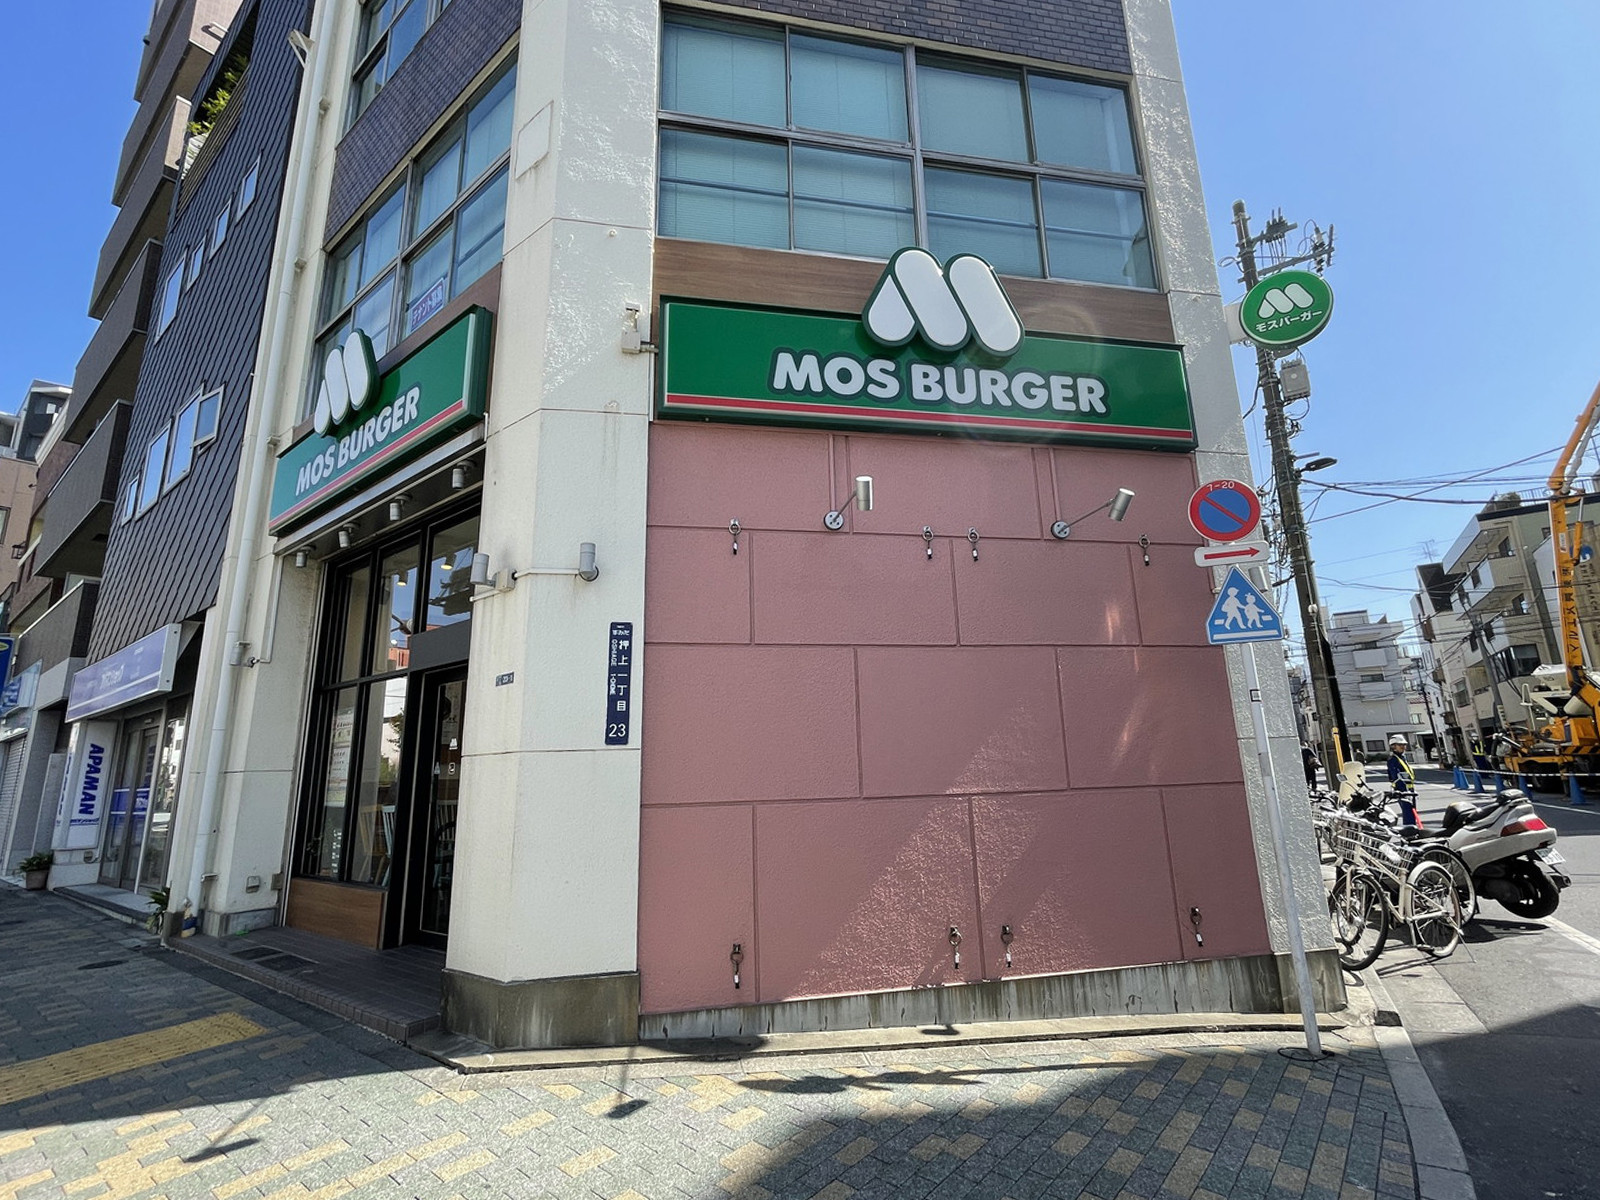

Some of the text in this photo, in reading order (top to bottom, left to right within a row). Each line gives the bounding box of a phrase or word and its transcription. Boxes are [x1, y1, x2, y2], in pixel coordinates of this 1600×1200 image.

[1255, 310, 1322, 332] モスバーガー
[773, 352, 1107, 414] MOS BURGER
[295, 386, 420, 497] MOS BURGER
[1206, 480, 1236, 492] 7-20
[616, 639, 630, 712] 押上一丁目
[608, 723, 626, 738] 23
[78, 743, 105, 815] APAMAN
